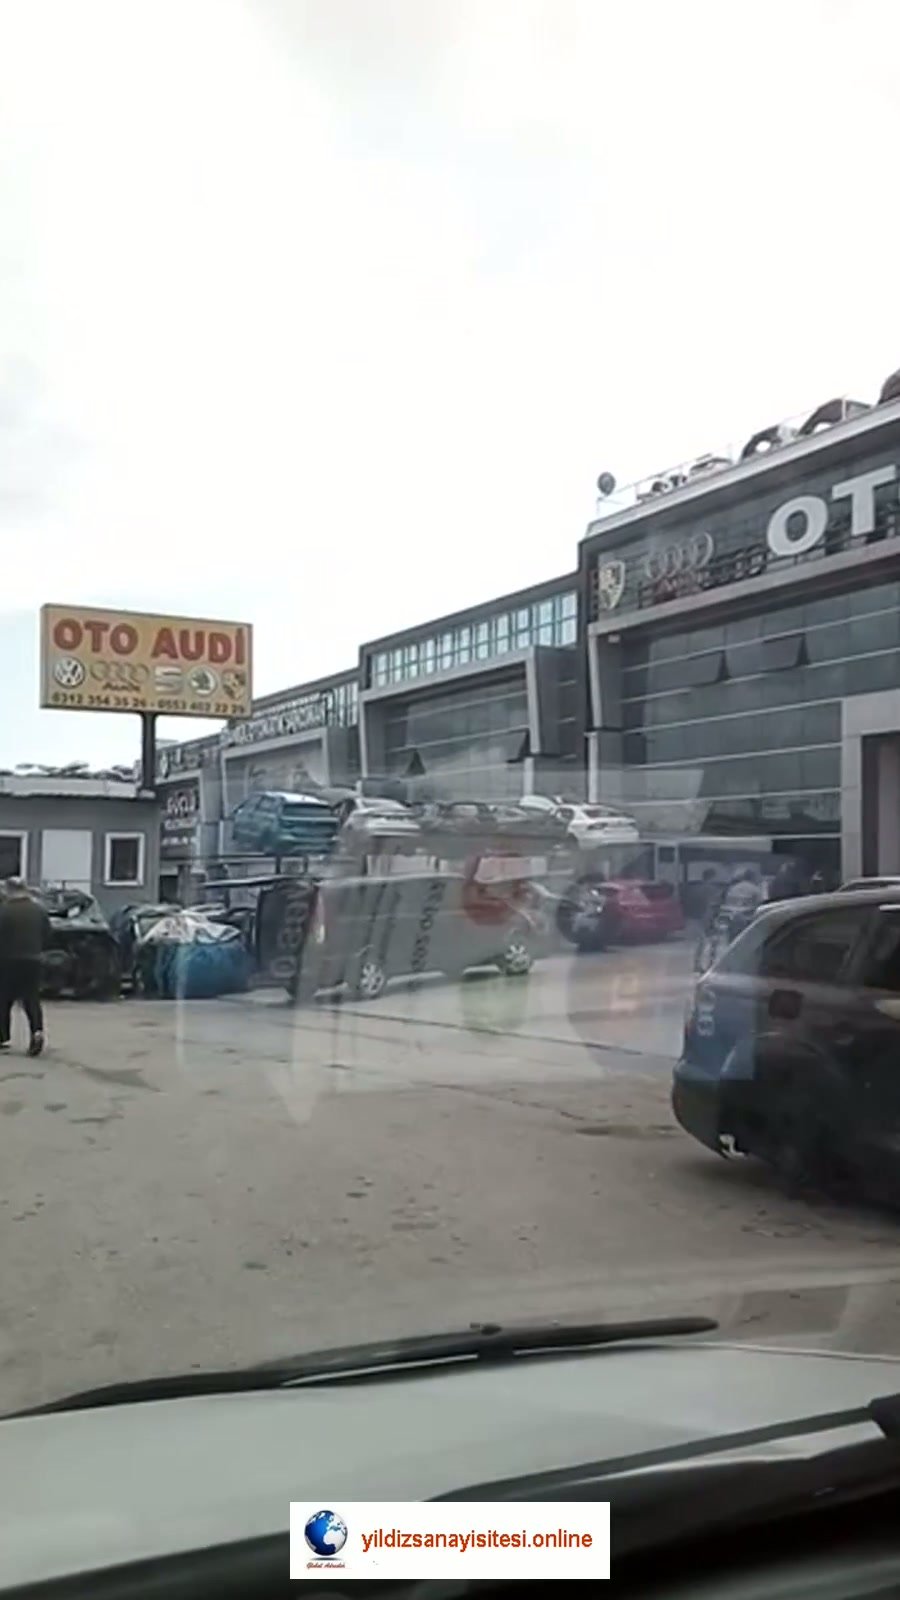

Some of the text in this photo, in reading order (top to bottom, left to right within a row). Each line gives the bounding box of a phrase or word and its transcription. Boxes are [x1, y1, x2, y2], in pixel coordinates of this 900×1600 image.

[766, 463, 900, 556] OT
[53, 617, 245, 665] OTO AUDİ
